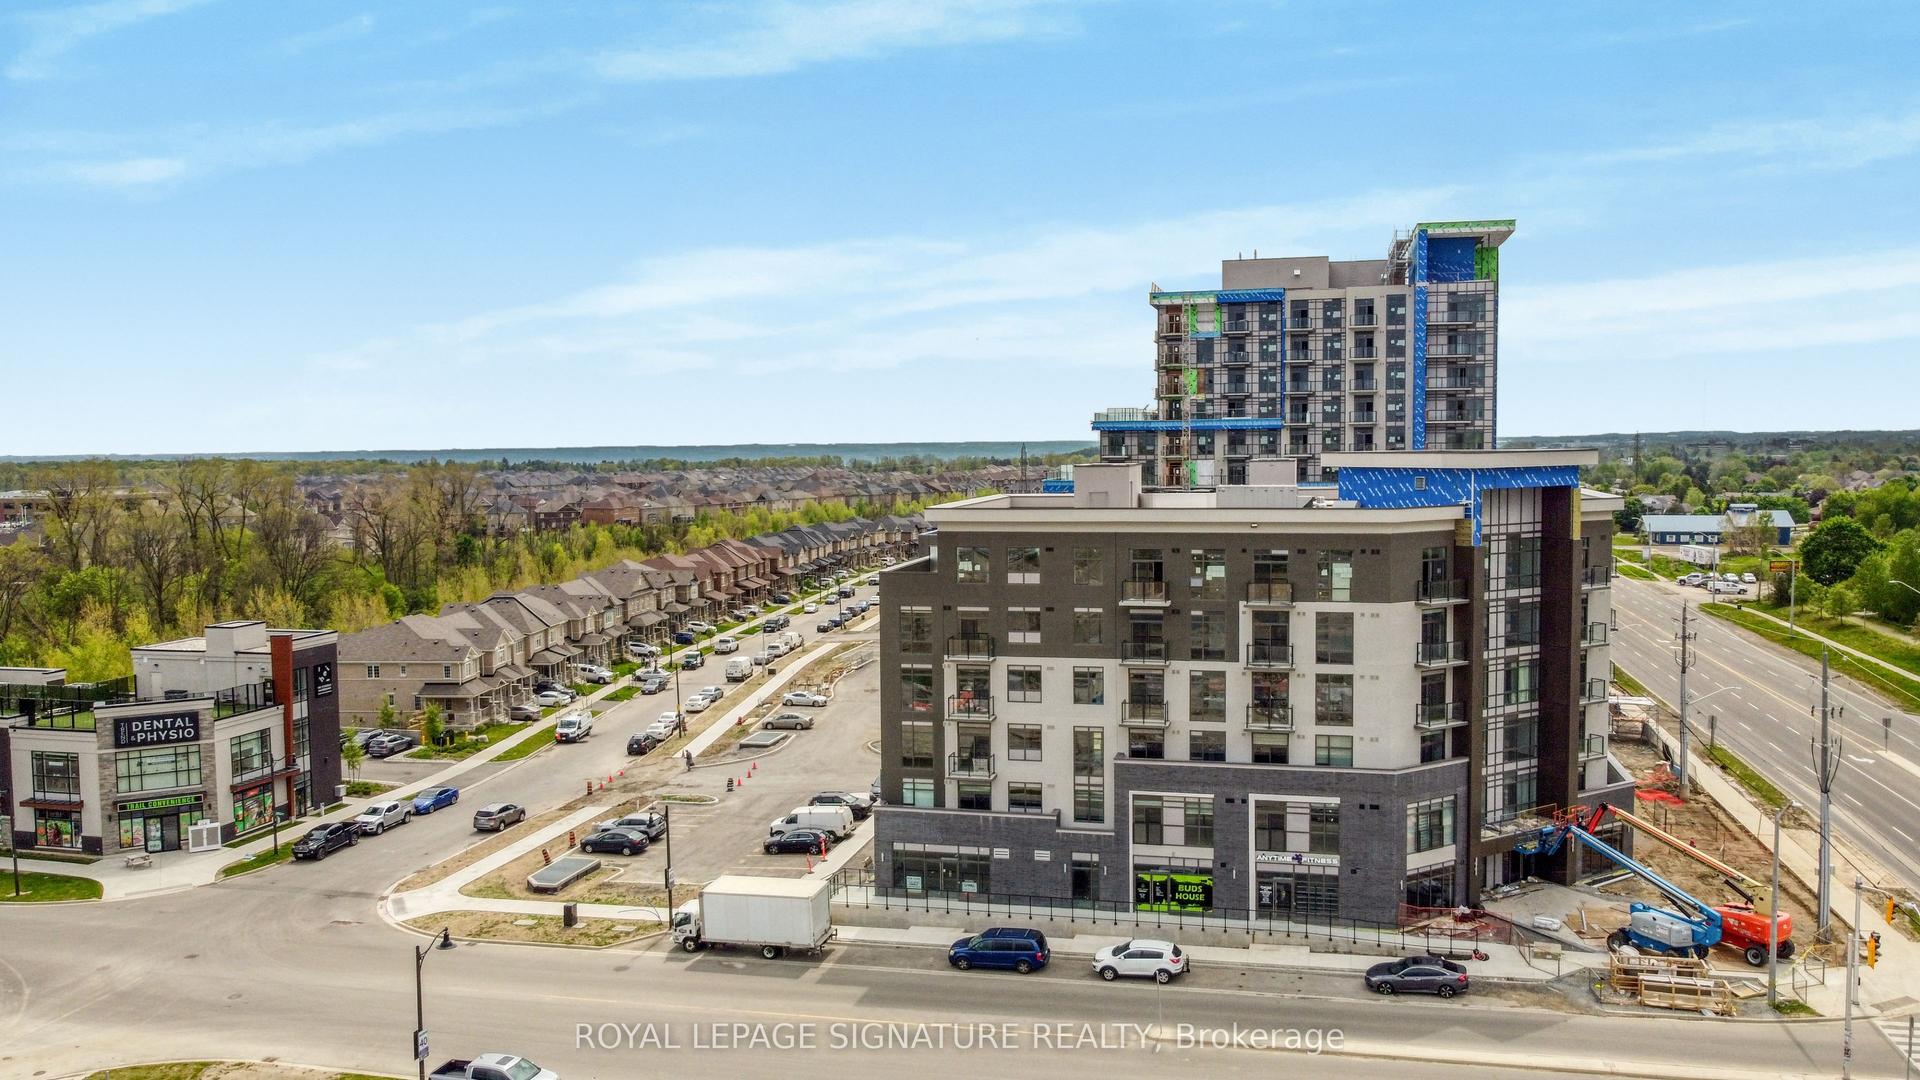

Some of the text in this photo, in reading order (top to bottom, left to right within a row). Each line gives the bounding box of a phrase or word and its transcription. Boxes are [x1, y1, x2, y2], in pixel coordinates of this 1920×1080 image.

[132, 717, 194, 732] DENTAL
[137, 728, 195, 743] PHYSIO
[127, 802, 144, 810] TRAIL
[1256, 853, 1338, 864] ANYTIME FITNESS
[1178, 884, 1203, 893] BUDS
[1175, 892, 1205, 901] HOUSE
